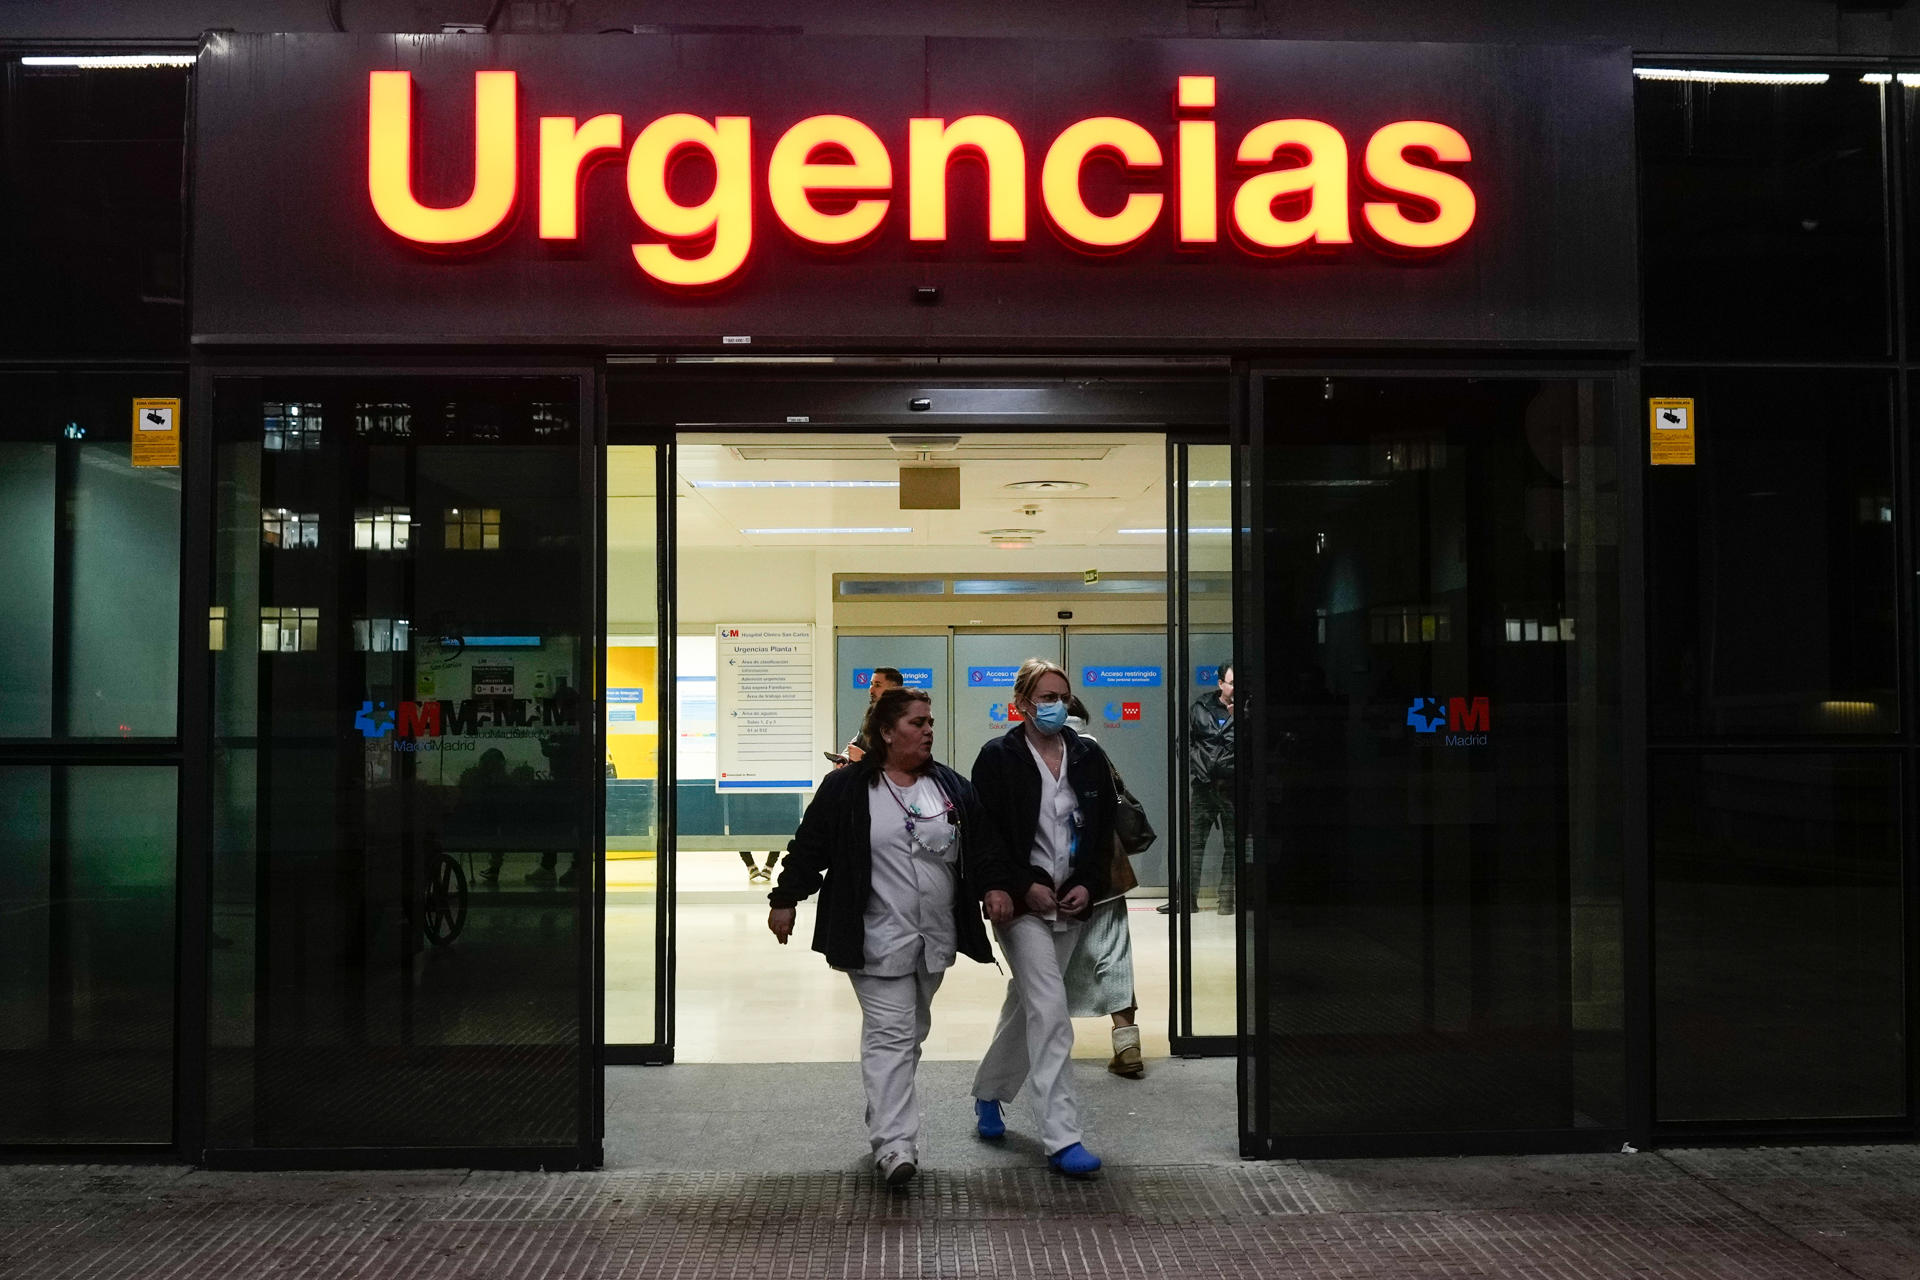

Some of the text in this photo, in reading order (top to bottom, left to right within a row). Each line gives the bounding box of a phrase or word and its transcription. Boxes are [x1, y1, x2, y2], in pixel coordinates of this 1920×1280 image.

[367, 70, 1478, 287] Urgencias
[729, 629, 739, 638] M
[1124, 670, 1157, 678] restringido
[398, 701, 440, 736] M
[1449, 696, 1490, 732] M
[1445, 734, 1487, 746] Madrid
